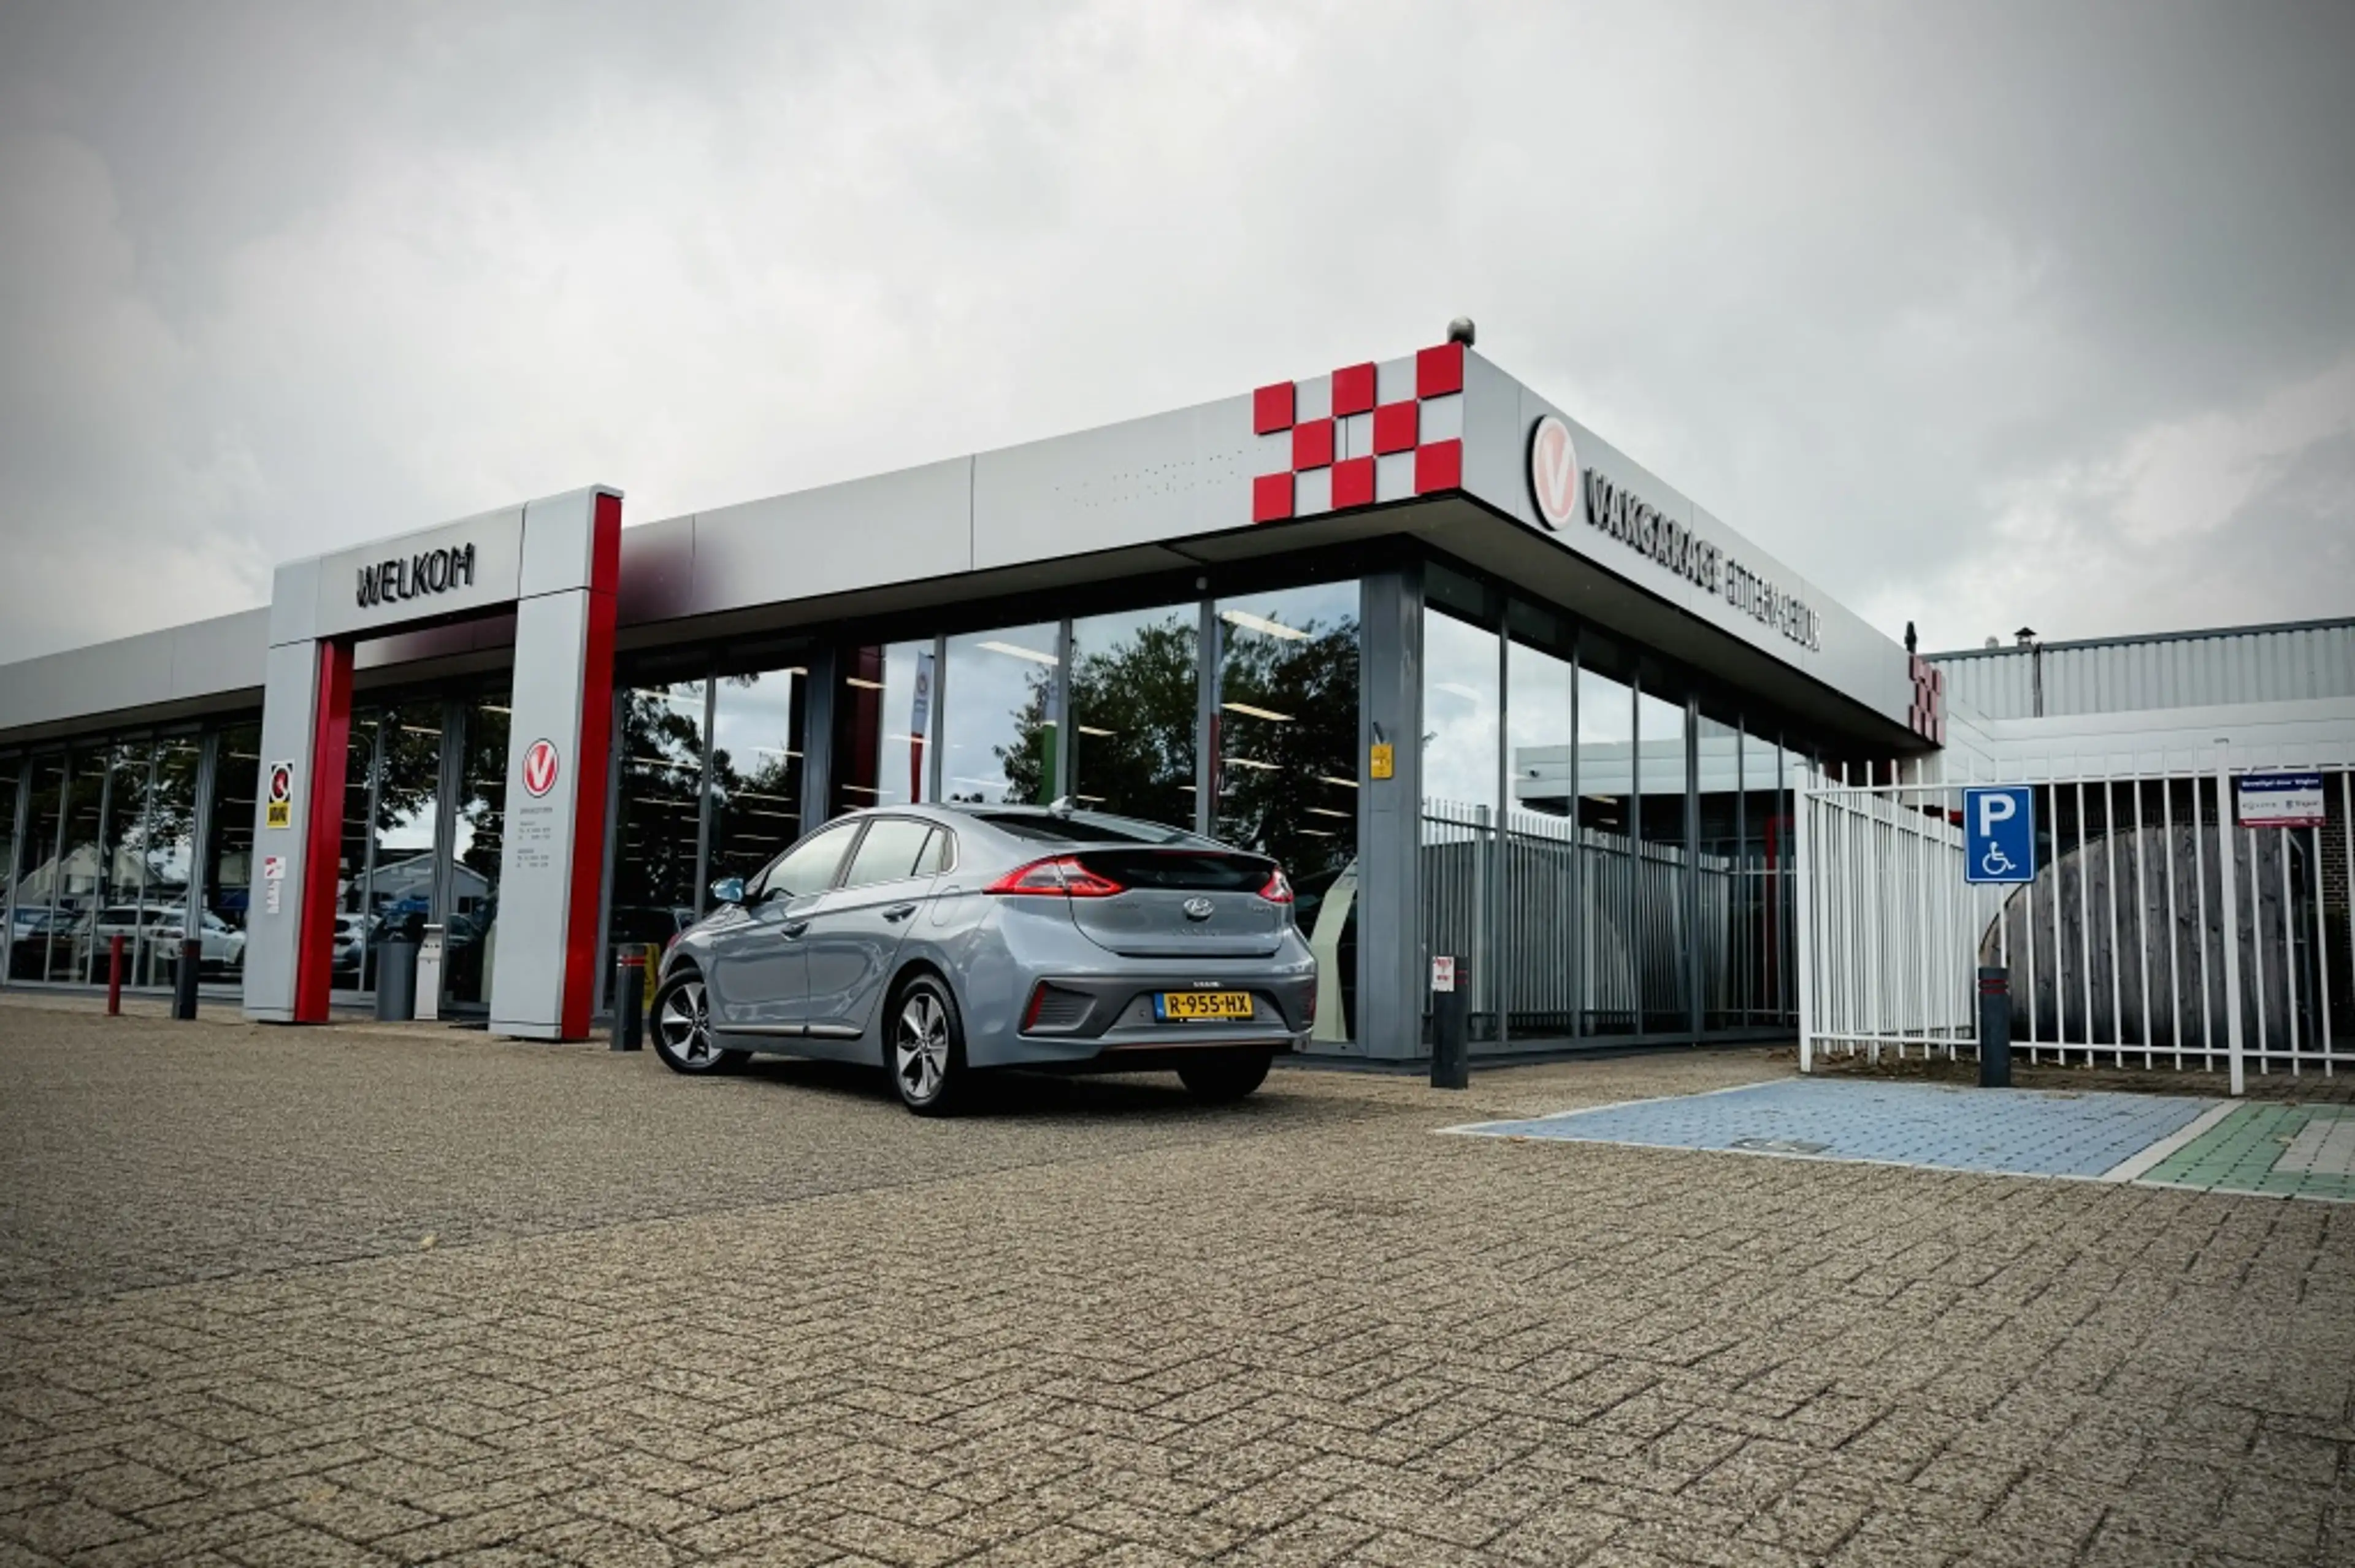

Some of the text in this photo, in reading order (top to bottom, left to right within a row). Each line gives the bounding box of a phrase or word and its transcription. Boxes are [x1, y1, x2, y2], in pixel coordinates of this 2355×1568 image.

[1583, 467, 1723, 595] VAKGARAGE
[356, 542, 476, 608] WELKOM
[1980, 794, 2016, 836] P
[1169, 995, 1248, 1014] R-955-HX
